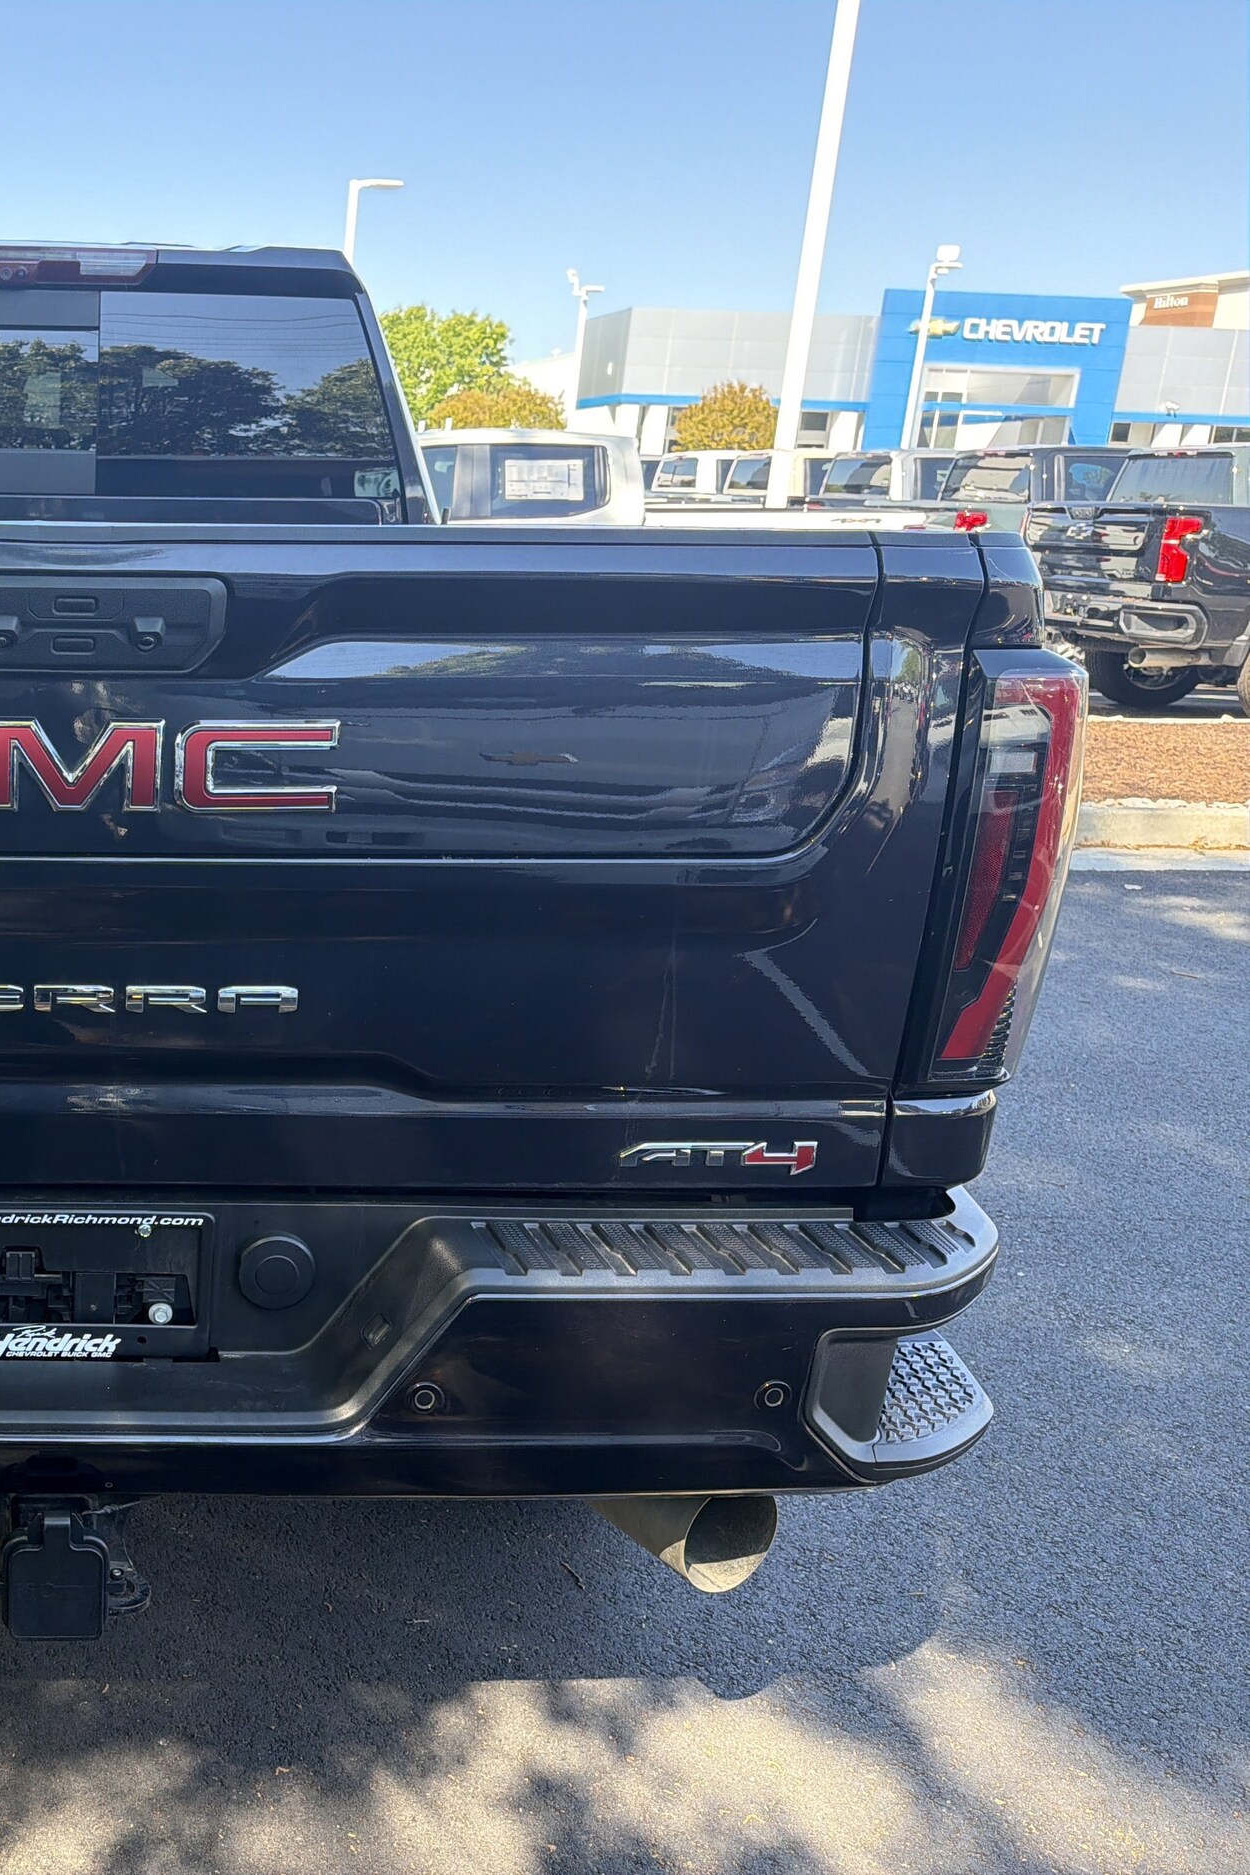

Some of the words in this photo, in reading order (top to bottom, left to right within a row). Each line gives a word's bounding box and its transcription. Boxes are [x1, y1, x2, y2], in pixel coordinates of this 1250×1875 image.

[1153, 294, 1189, 309] Hilton
[962, 317, 1106, 346] CHEVROLET
[619, 1141, 819, 1176] AT4
